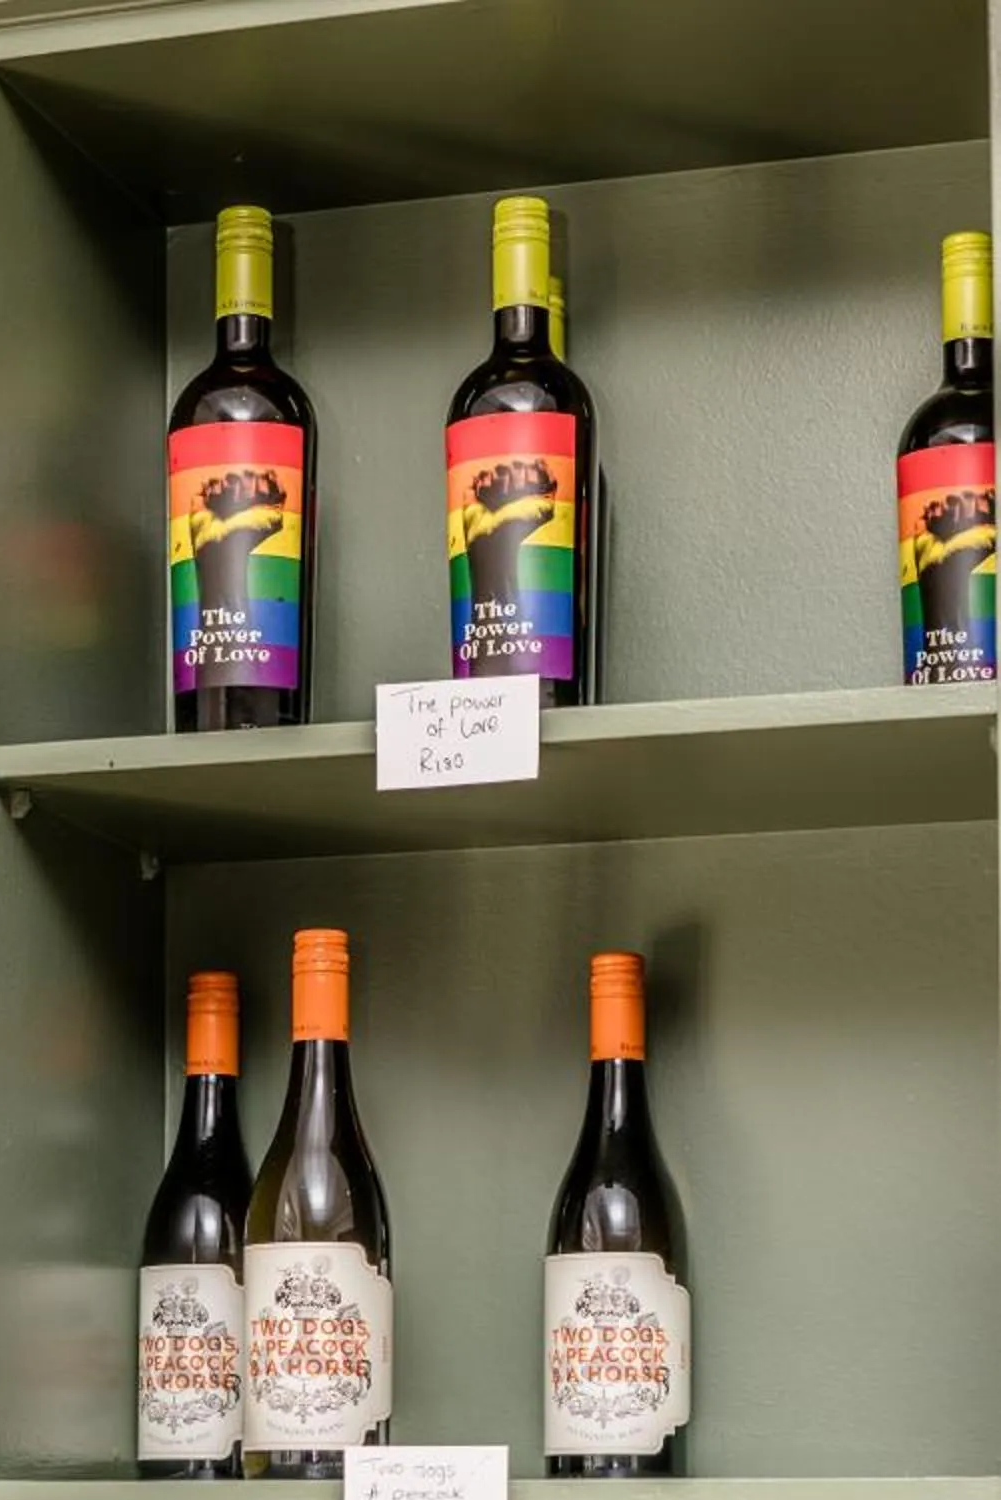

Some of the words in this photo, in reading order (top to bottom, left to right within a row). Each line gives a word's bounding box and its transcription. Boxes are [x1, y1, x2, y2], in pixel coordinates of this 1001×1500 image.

[202, 607, 247, 627] The
[474, 599, 518, 619] The
[189, 629, 263, 648] Power
[464, 621, 534, 641] Power
[926, 626, 969, 648] The
[184, 646, 208, 667] Of
[214, 646, 272, 664] Love
[460, 639, 480, 661] Of
[485, 639, 543, 657] Love
[915, 647, 985, 669] Power
[911, 666, 932, 685] Of
[937, 665, 995, 683] Love
[390, 686, 437, 715] The
[449, 694, 507, 718] power
[426, 717, 449, 739] of
[251, 1318, 292, 1337] TWO
[552, 1326, 593, 1346] TWO
[143, 1336, 166, 1353] WO
[266, 1339, 366, 1357] PEACOCK
[566, 1346, 665, 1363] PEACOCK
[146, 1355, 237, 1373] PEACOCK
[287, 1359, 368, 1378] HORSE
[162, 1373, 237, 1391] HORSE
[587, 1366, 667, 1384] HORSE
